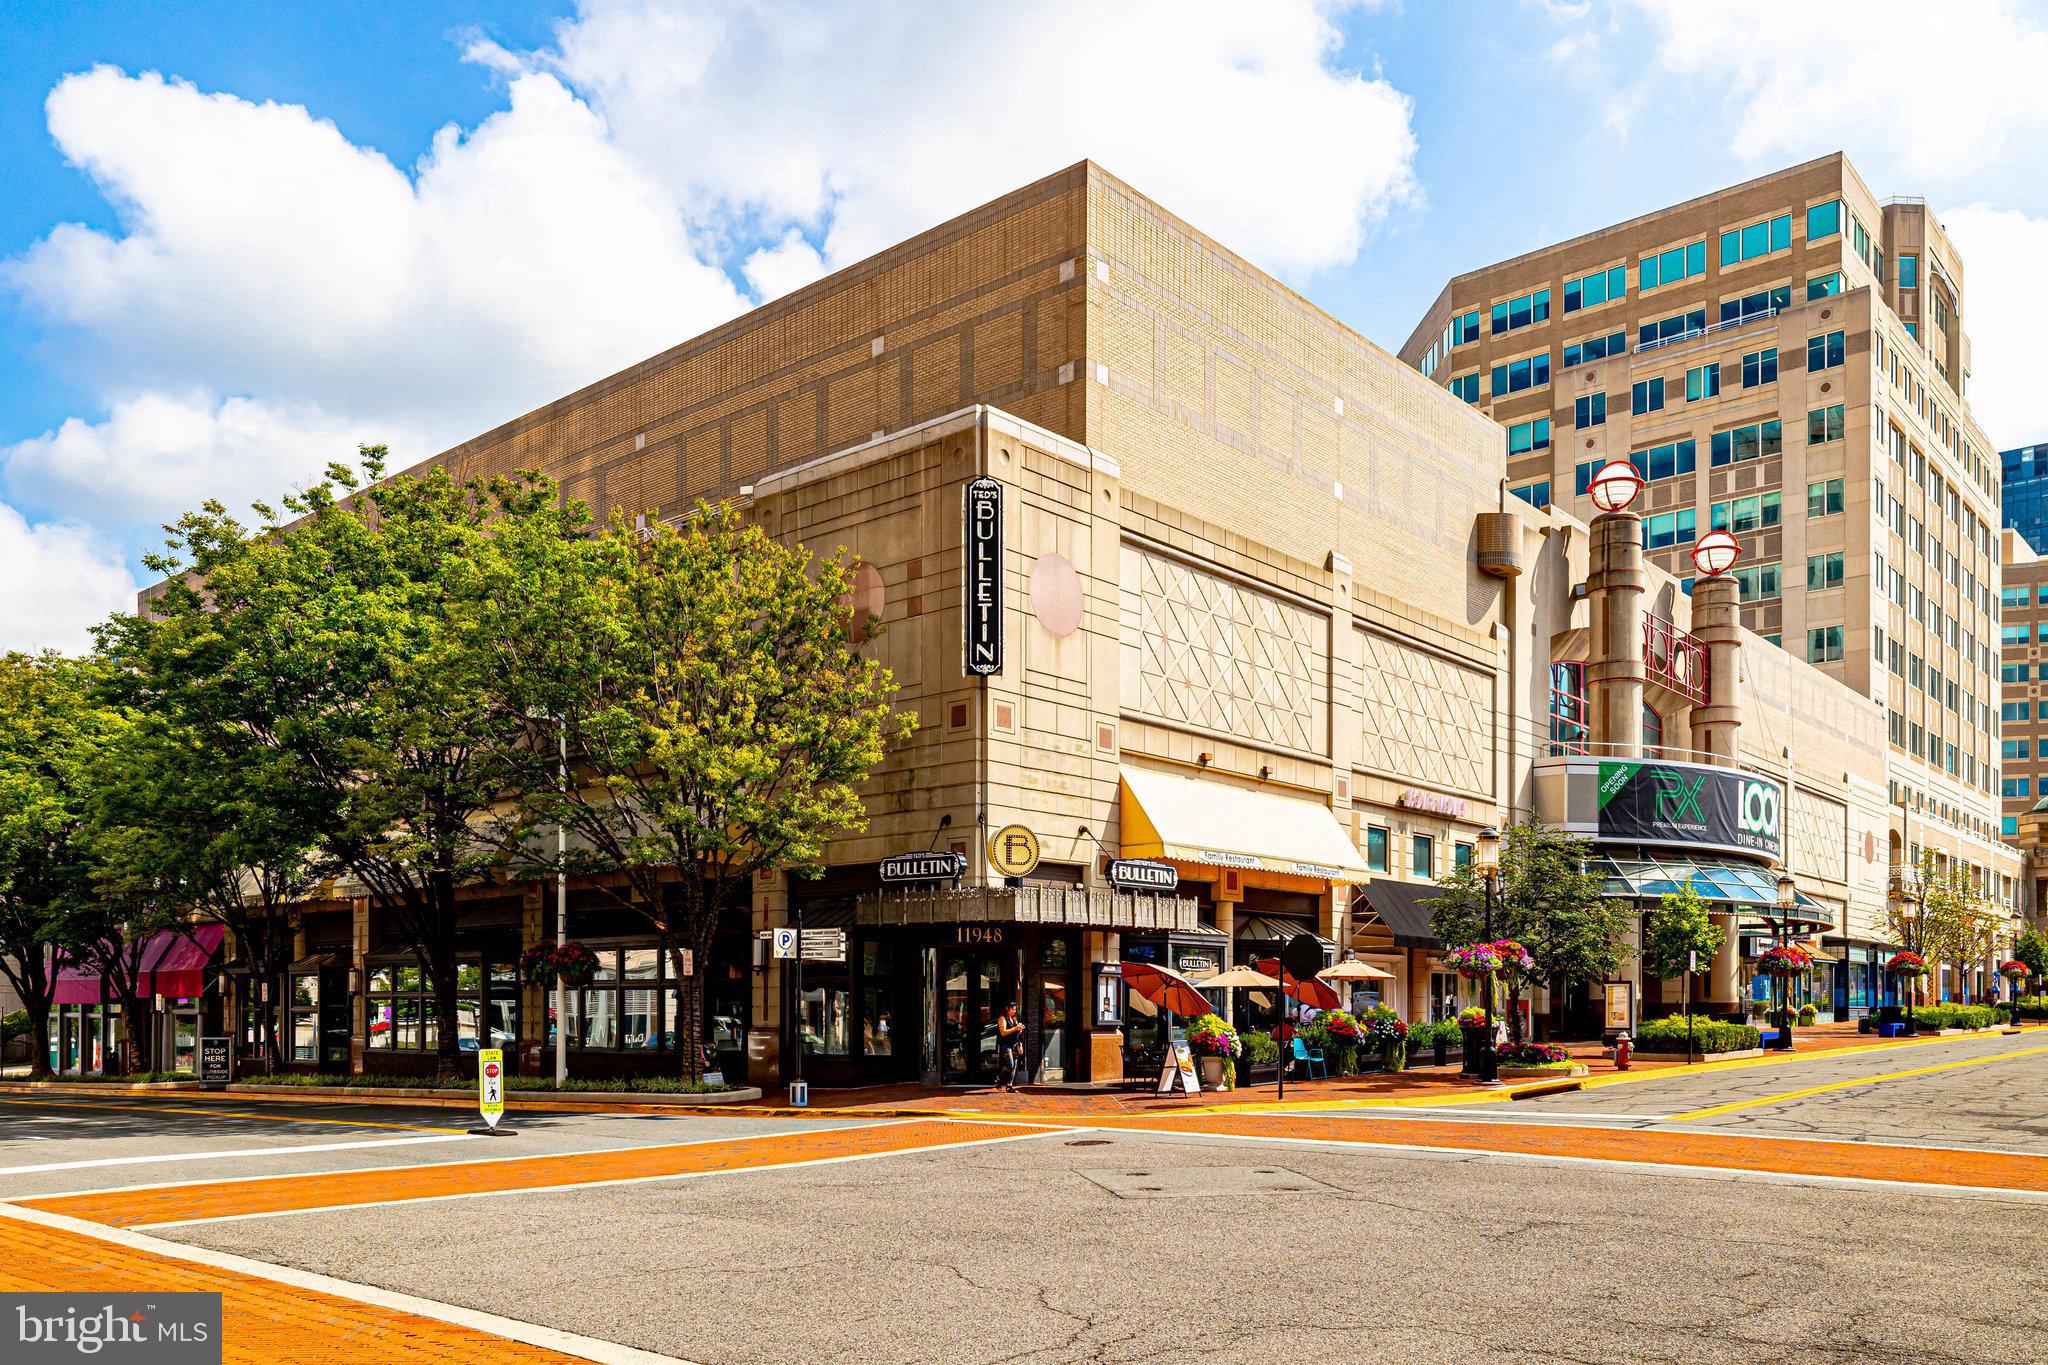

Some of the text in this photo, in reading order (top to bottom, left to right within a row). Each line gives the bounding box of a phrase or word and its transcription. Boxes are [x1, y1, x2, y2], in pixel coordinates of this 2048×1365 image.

[973, 490, 997, 499] TED'S
[976, 501, 994, 662] BULLETIN
[1600, 764, 1628, 793] OPENING
[1610, 775, 1629, 794] SOON
[1650, 770, 1706, 823] PX
[1738, 780, 1780, 840] LOOK
[1678, 823, 1708, 832] EXPERIENCE
[1738, 833, 1763, 849] DINE-IN
[1003, 834, 1032, 866] B
[1204, 851, 1255, 864] Family Restaurant
[887, 859, 952, 877] BULLETIN
[1118, 865, 1173, 884] BULLETIN
[1296, 863, 1313, 874] Family
[782, 934, 790, 946] P
[957, 926, 1003, 943] 11948
[1182, 959, 1210, 969] BULLETIN
